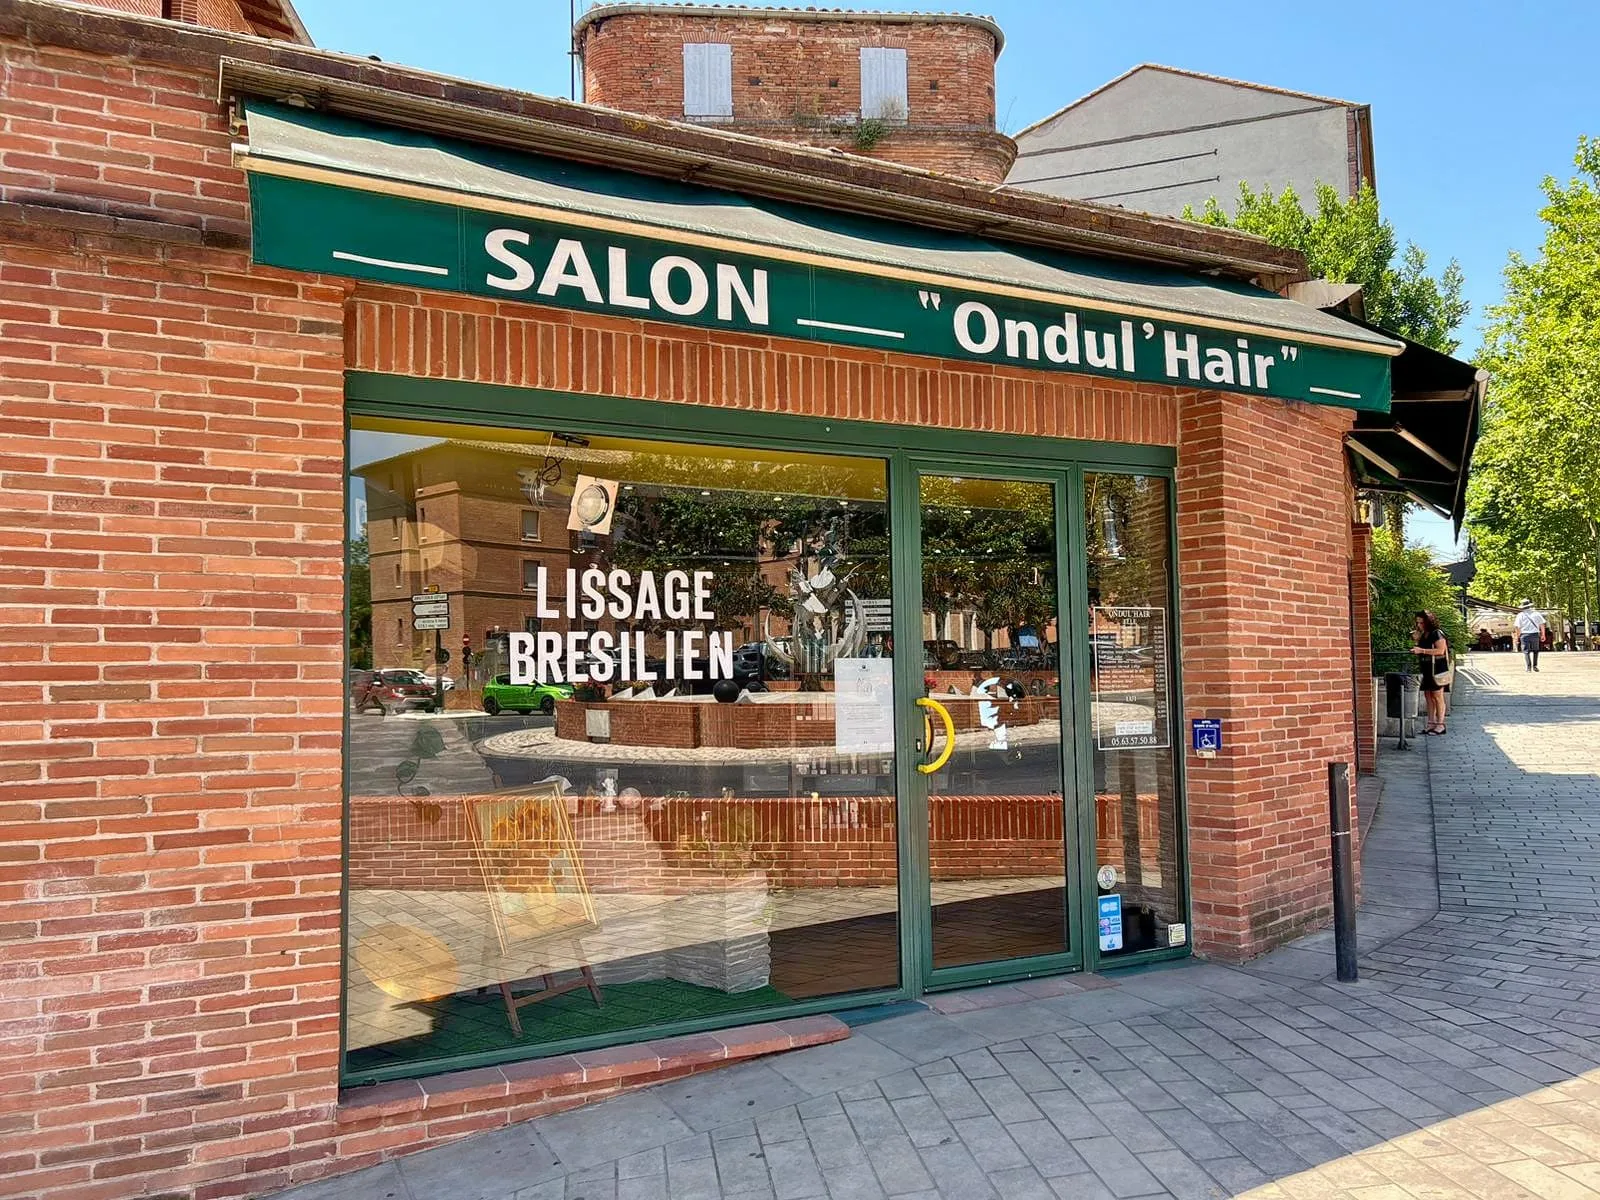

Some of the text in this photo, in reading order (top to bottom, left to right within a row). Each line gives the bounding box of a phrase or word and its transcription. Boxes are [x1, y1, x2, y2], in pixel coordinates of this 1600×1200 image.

[484, 228, 769, 325] SALON
[536, 566, 715, 620] LISSAGE
[509, 630, 734, 685] BRESILIEN
